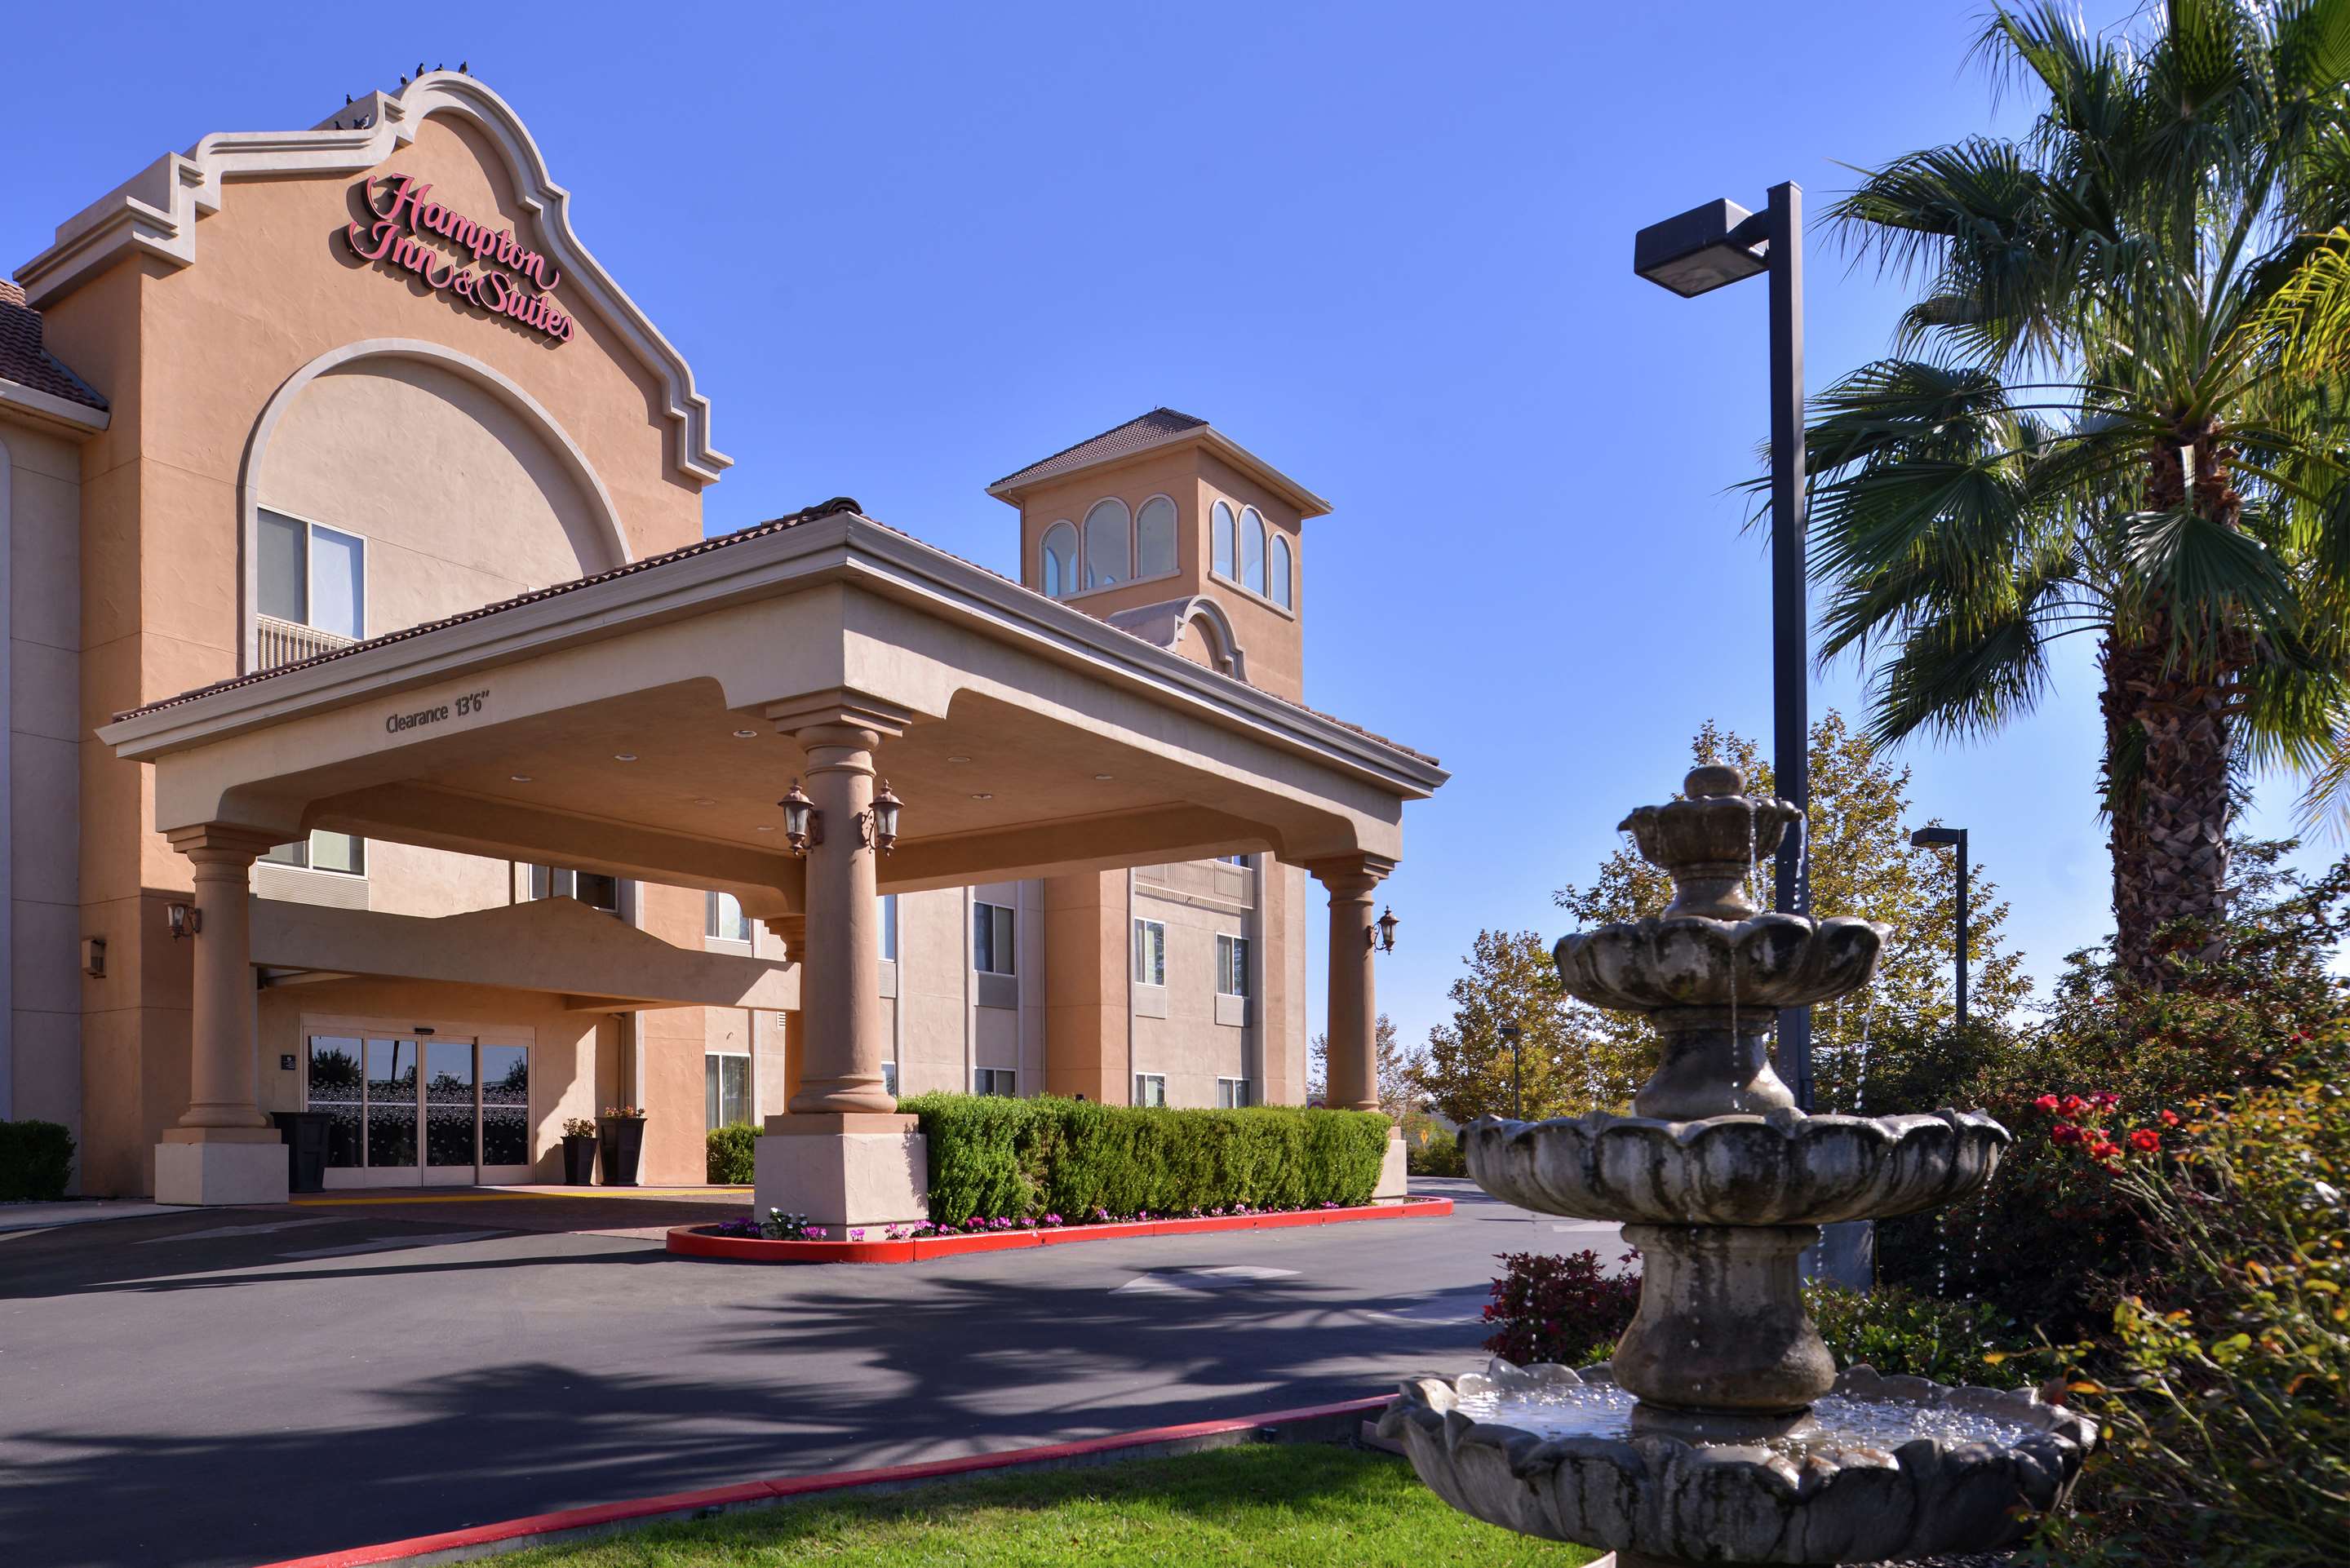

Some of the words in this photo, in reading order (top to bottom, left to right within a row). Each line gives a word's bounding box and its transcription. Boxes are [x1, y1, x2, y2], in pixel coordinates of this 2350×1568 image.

[348, 220, 454, 289] Inn
[454, 268, 480, 306] &
[477, 270, 574, 342] Suites
[366, 173, 561, 290] Hampton
[386, 705, 449, 733] Clearance
